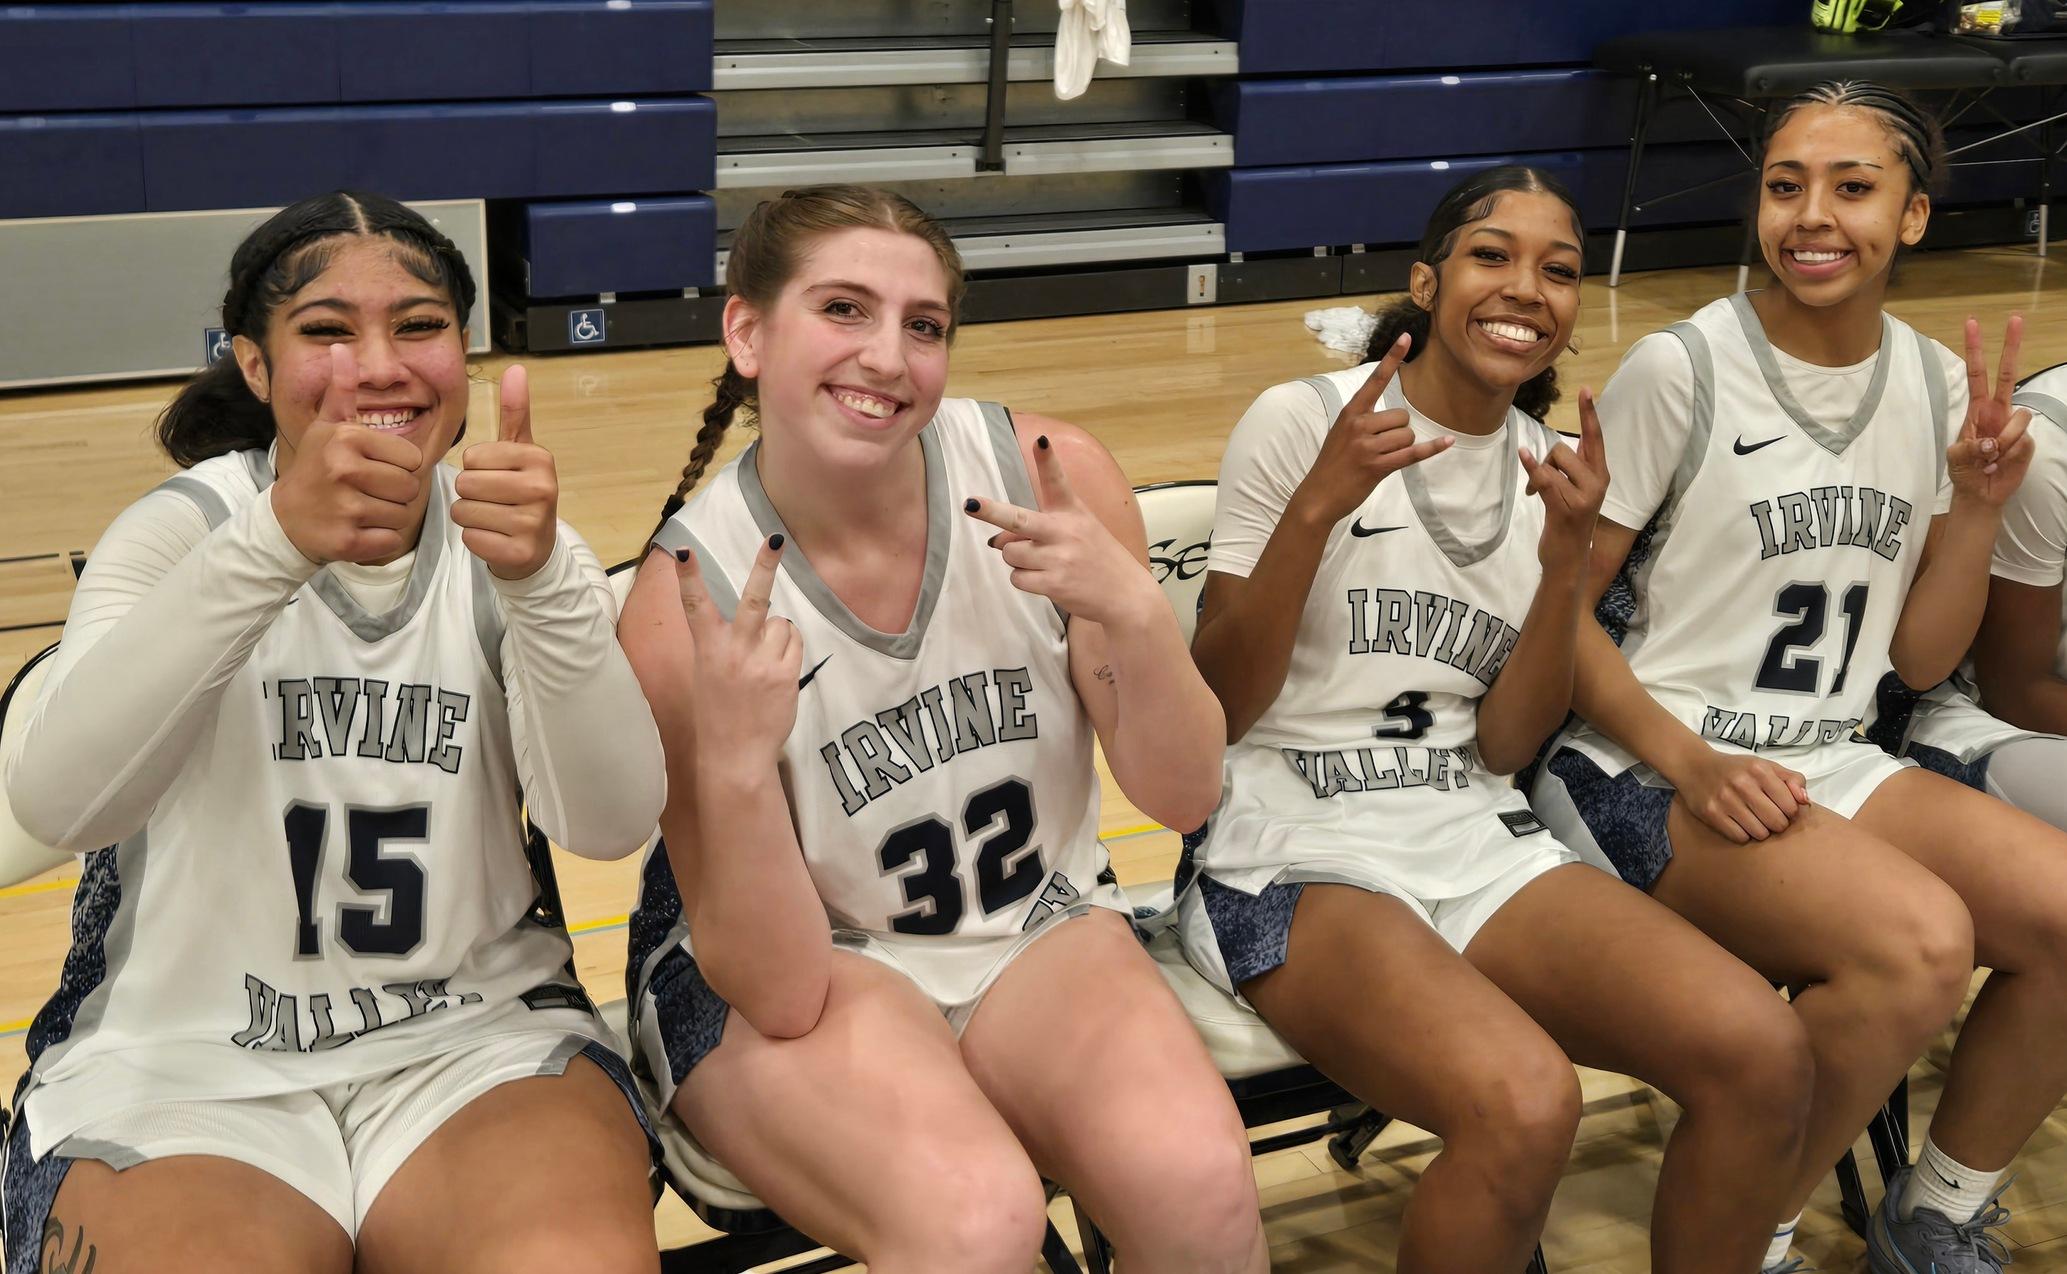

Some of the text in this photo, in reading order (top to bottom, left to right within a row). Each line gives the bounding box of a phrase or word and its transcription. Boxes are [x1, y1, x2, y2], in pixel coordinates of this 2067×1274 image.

[1750, 486, 1913, 561] IRVINE
[1347, 588, 1520, 687] IRVINE
[1750, 579, 1870, 698] 21
[263, 676, 470, 774] RVINE
[820, 666, 1038, 817] IRVINE
[282, 798, 433, 962] 15
[874, 774, 1048, 936] 32
